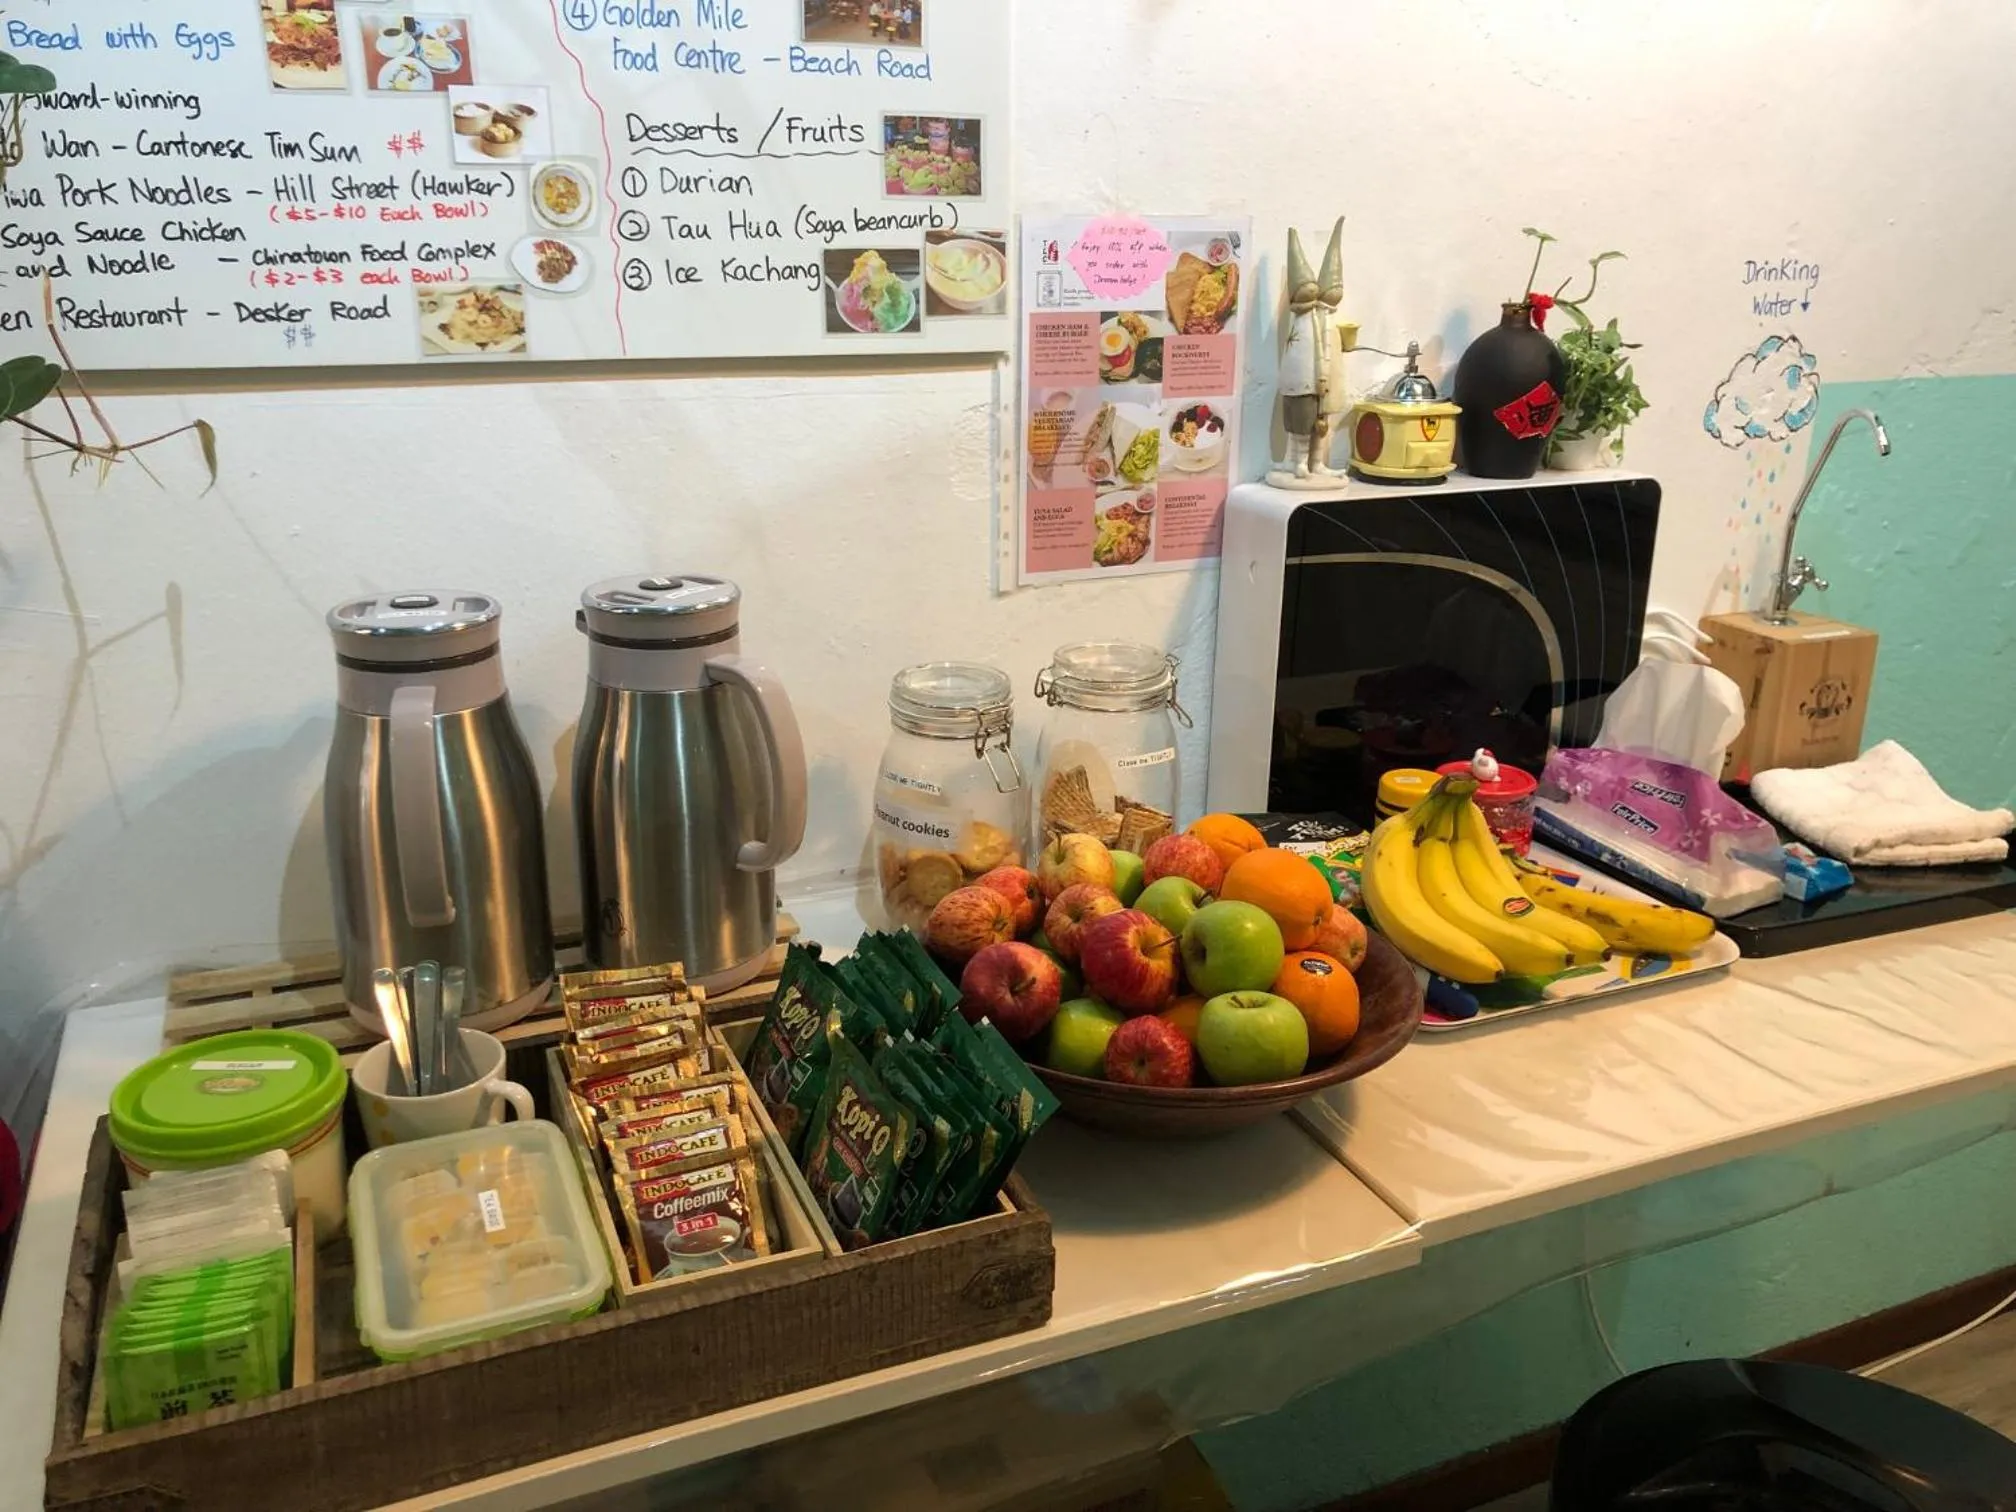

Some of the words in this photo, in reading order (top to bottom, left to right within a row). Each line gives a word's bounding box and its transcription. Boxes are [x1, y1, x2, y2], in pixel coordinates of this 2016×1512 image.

[603, 0, 679, 28] Golden
[697, 0, 749, 31] Mile
[7, 20, 82, 50] Bread
[105, 22, 158, 49] with
[175, 23, 235, 61] Eggs
[613, 36, 658, 72] Food
[675, 40, 746, 75] Centre
[789, 46, 862, 76] Beach
[877, 50, 932, 81] Road
[41, 129, 100, 158] Wan
[136, 129, 252, 159] Cantonese
[265, 132, 304, 161] Tim
[626, 112, 739, 144] Desserts
[55, 173, 119, 208] Pork
[128, 175, 232, 206] Noodles
[273, 173, 316, 203] Hill
[331, 175, 399, 200] Street
[660, 167, 753, 196] Durian
[0, 223, 65, 256] Soya
[74, 221, 146, 243] Sauce
[161, 217, 247, 243] Chicken
[661, 216, 713, 240] Tau
[795, 204, 847, 243] (Soya
[854, 203, 959, 232] beancurb)
[87, 250, 175, 276] Noodle
[252, 244, 352, 266] Chinatown
[360, 241, 408, 263] Food
[417, 240, 496, 265] Complex
[666, 259, 703, 284] Ice
[721, 255, 821, 291] Kachang
[55, 296, 188, 331] Restaurant
[330, 294, 391, 322] Road
[1752, 292, 1797, 318] Water
[901, 821, 950, 839] cookies
[653, 1187, 729, 1219] Coffeemix
